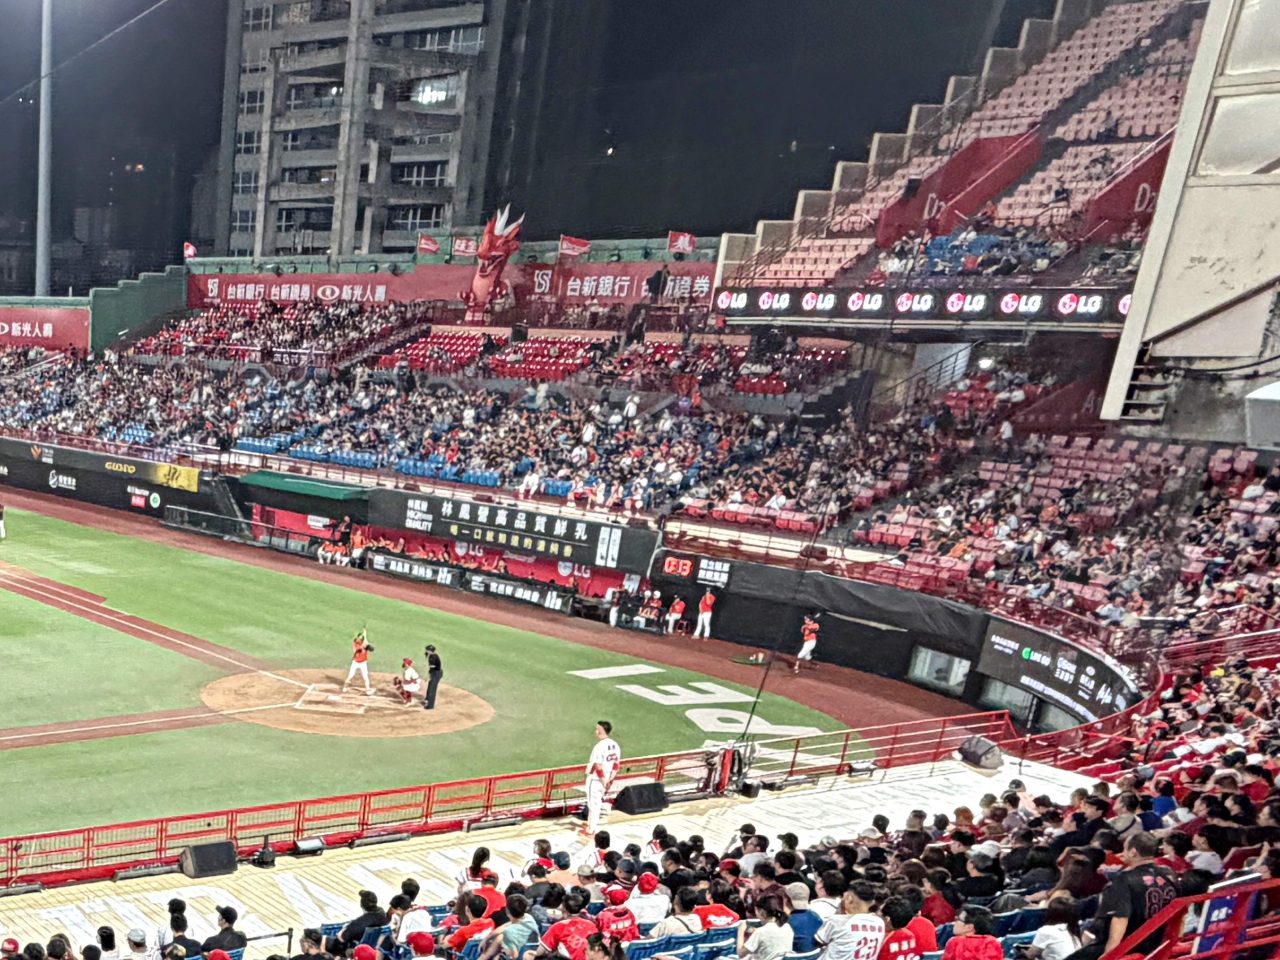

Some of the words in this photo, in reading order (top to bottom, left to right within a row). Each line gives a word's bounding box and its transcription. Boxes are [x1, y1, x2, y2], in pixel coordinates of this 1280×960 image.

[567, 275, 630, 297] 台新銀行
[641, 275, 710, 297] 證券
[730, 294, 747, 307] LG
[773, 294, 790, 308] LG
[817, 295, 835, 309] LG
[862, 294, 882, 310] LG
[911, 295, 933, 311] LG
[963, 295, 986, 311] LG
[1018, 295, 1042, 311] LG
[1076, 295, 1102, 312] LG
[441, 500, 588, 541] 林鳳營高品質鮮乳
[469, 543, 484, 557] LG
[573, 563, 592, 578] LG
